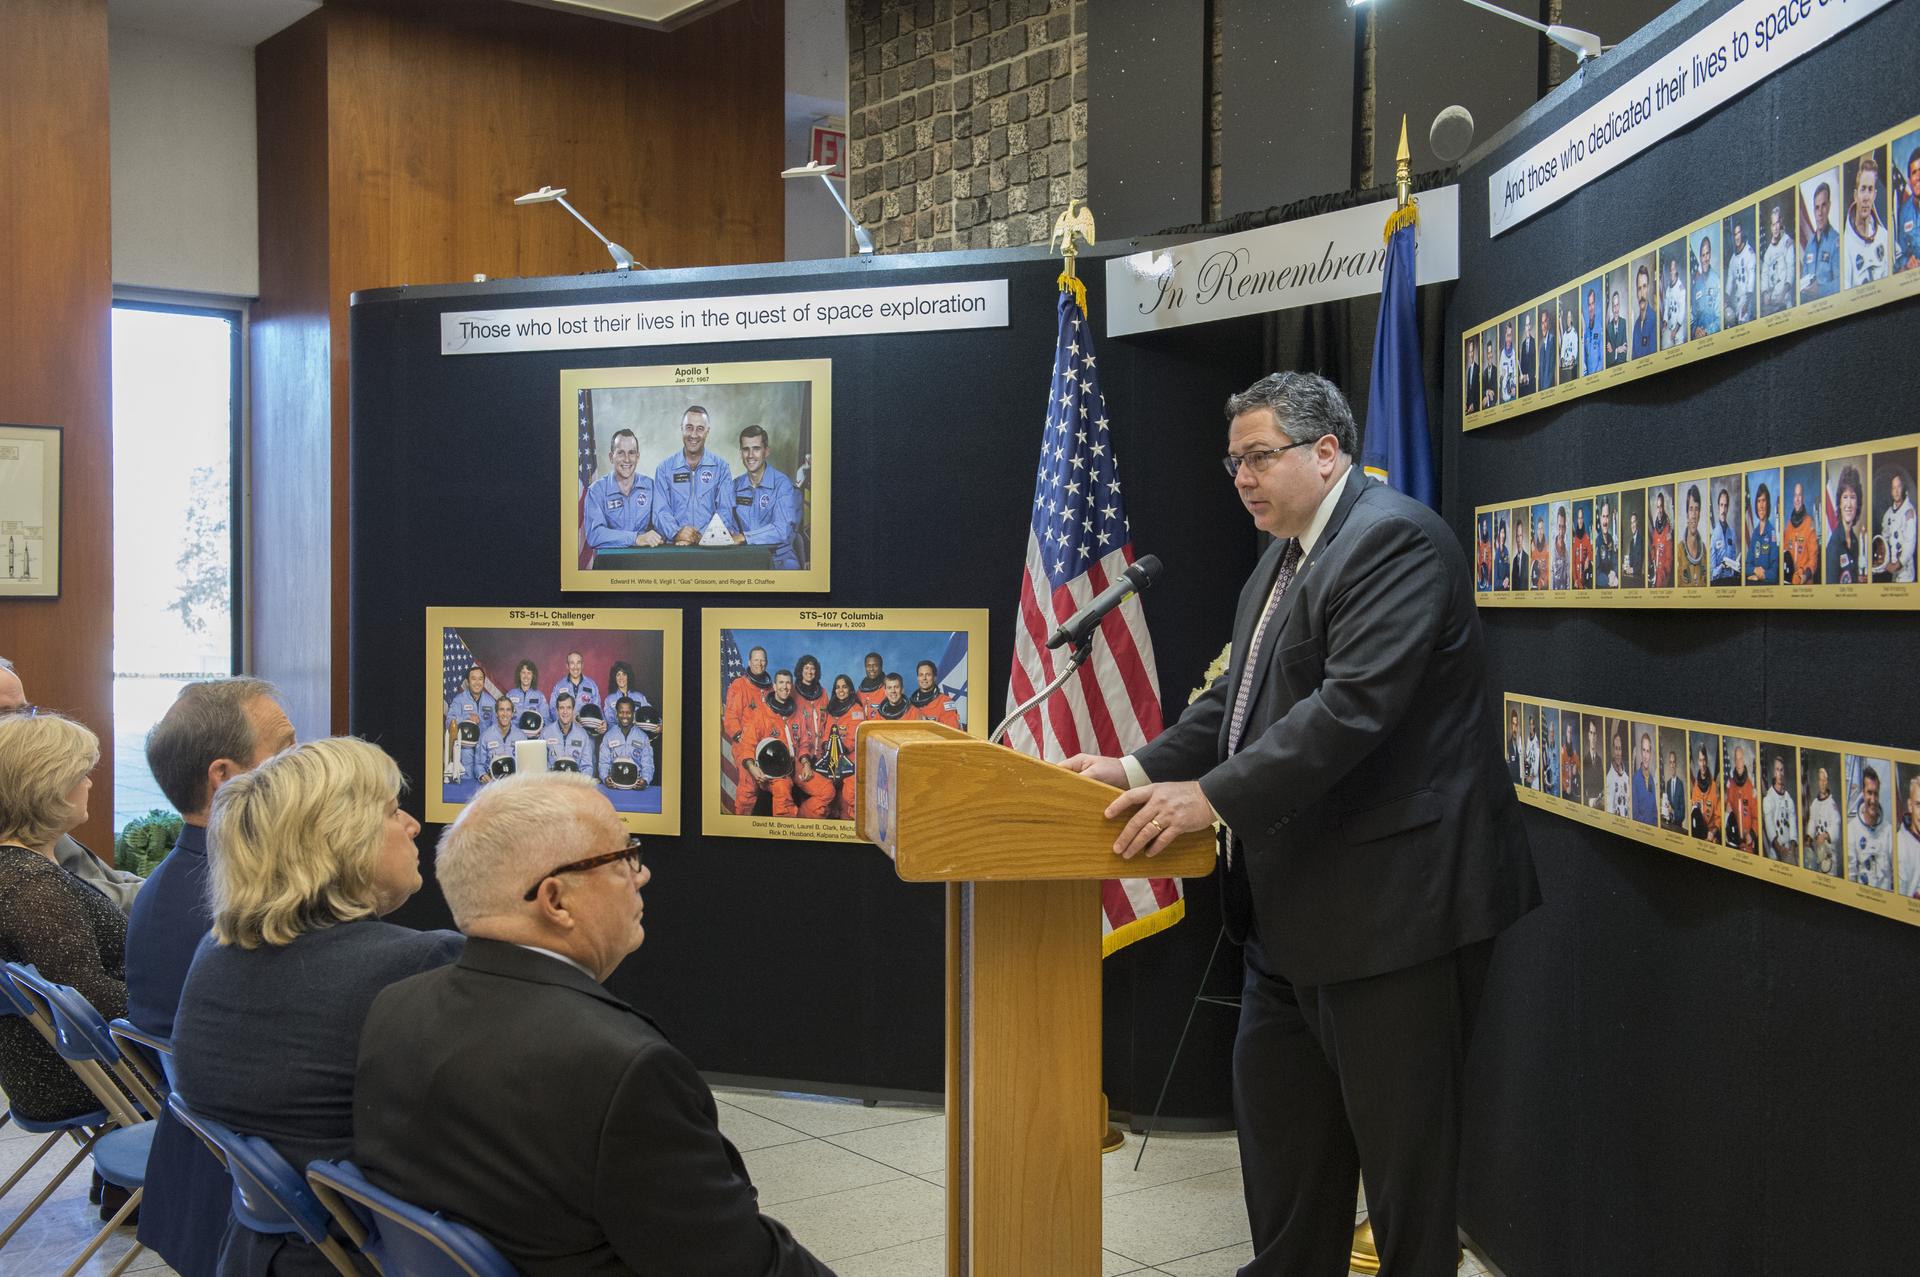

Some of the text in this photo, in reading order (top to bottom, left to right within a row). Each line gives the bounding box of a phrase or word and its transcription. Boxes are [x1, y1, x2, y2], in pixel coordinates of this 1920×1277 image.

[1503, 0, 1811, 207] And those who dedicated their lives to space
[1139, 240, 1387, 315] In Remembran
[458, 293, 986, 339] Those who lost their lives in the quest of space exploration
[674, 366, 709, 377] Apollo 1
[730, 578, 746, 587] Roger
[509, 610, 595, 621] STS-51-L Challenger
[799, 611, 884, 620] STS-107 Columbia
[752, 820, 768, 828] David
